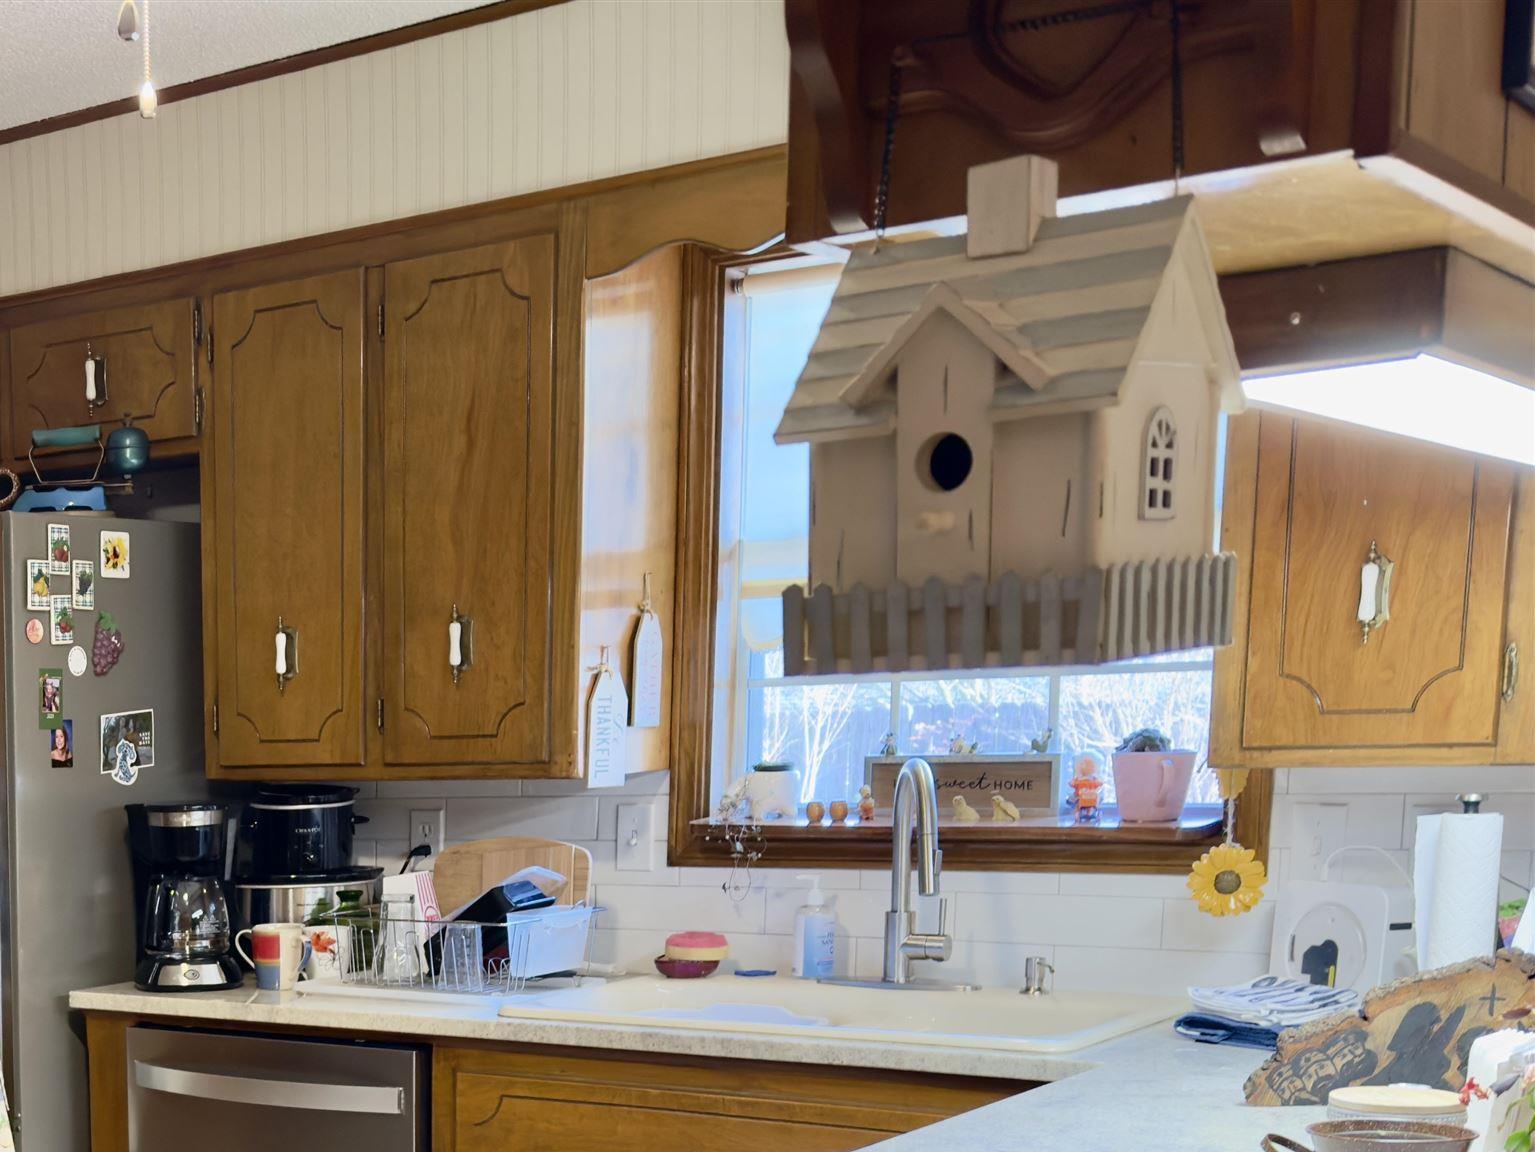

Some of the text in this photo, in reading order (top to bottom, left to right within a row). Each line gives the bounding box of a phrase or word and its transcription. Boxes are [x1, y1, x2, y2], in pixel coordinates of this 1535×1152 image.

[593, 695, 613, 780] THANKFUL
[936, 772, 1034, 791] sweet HOME
